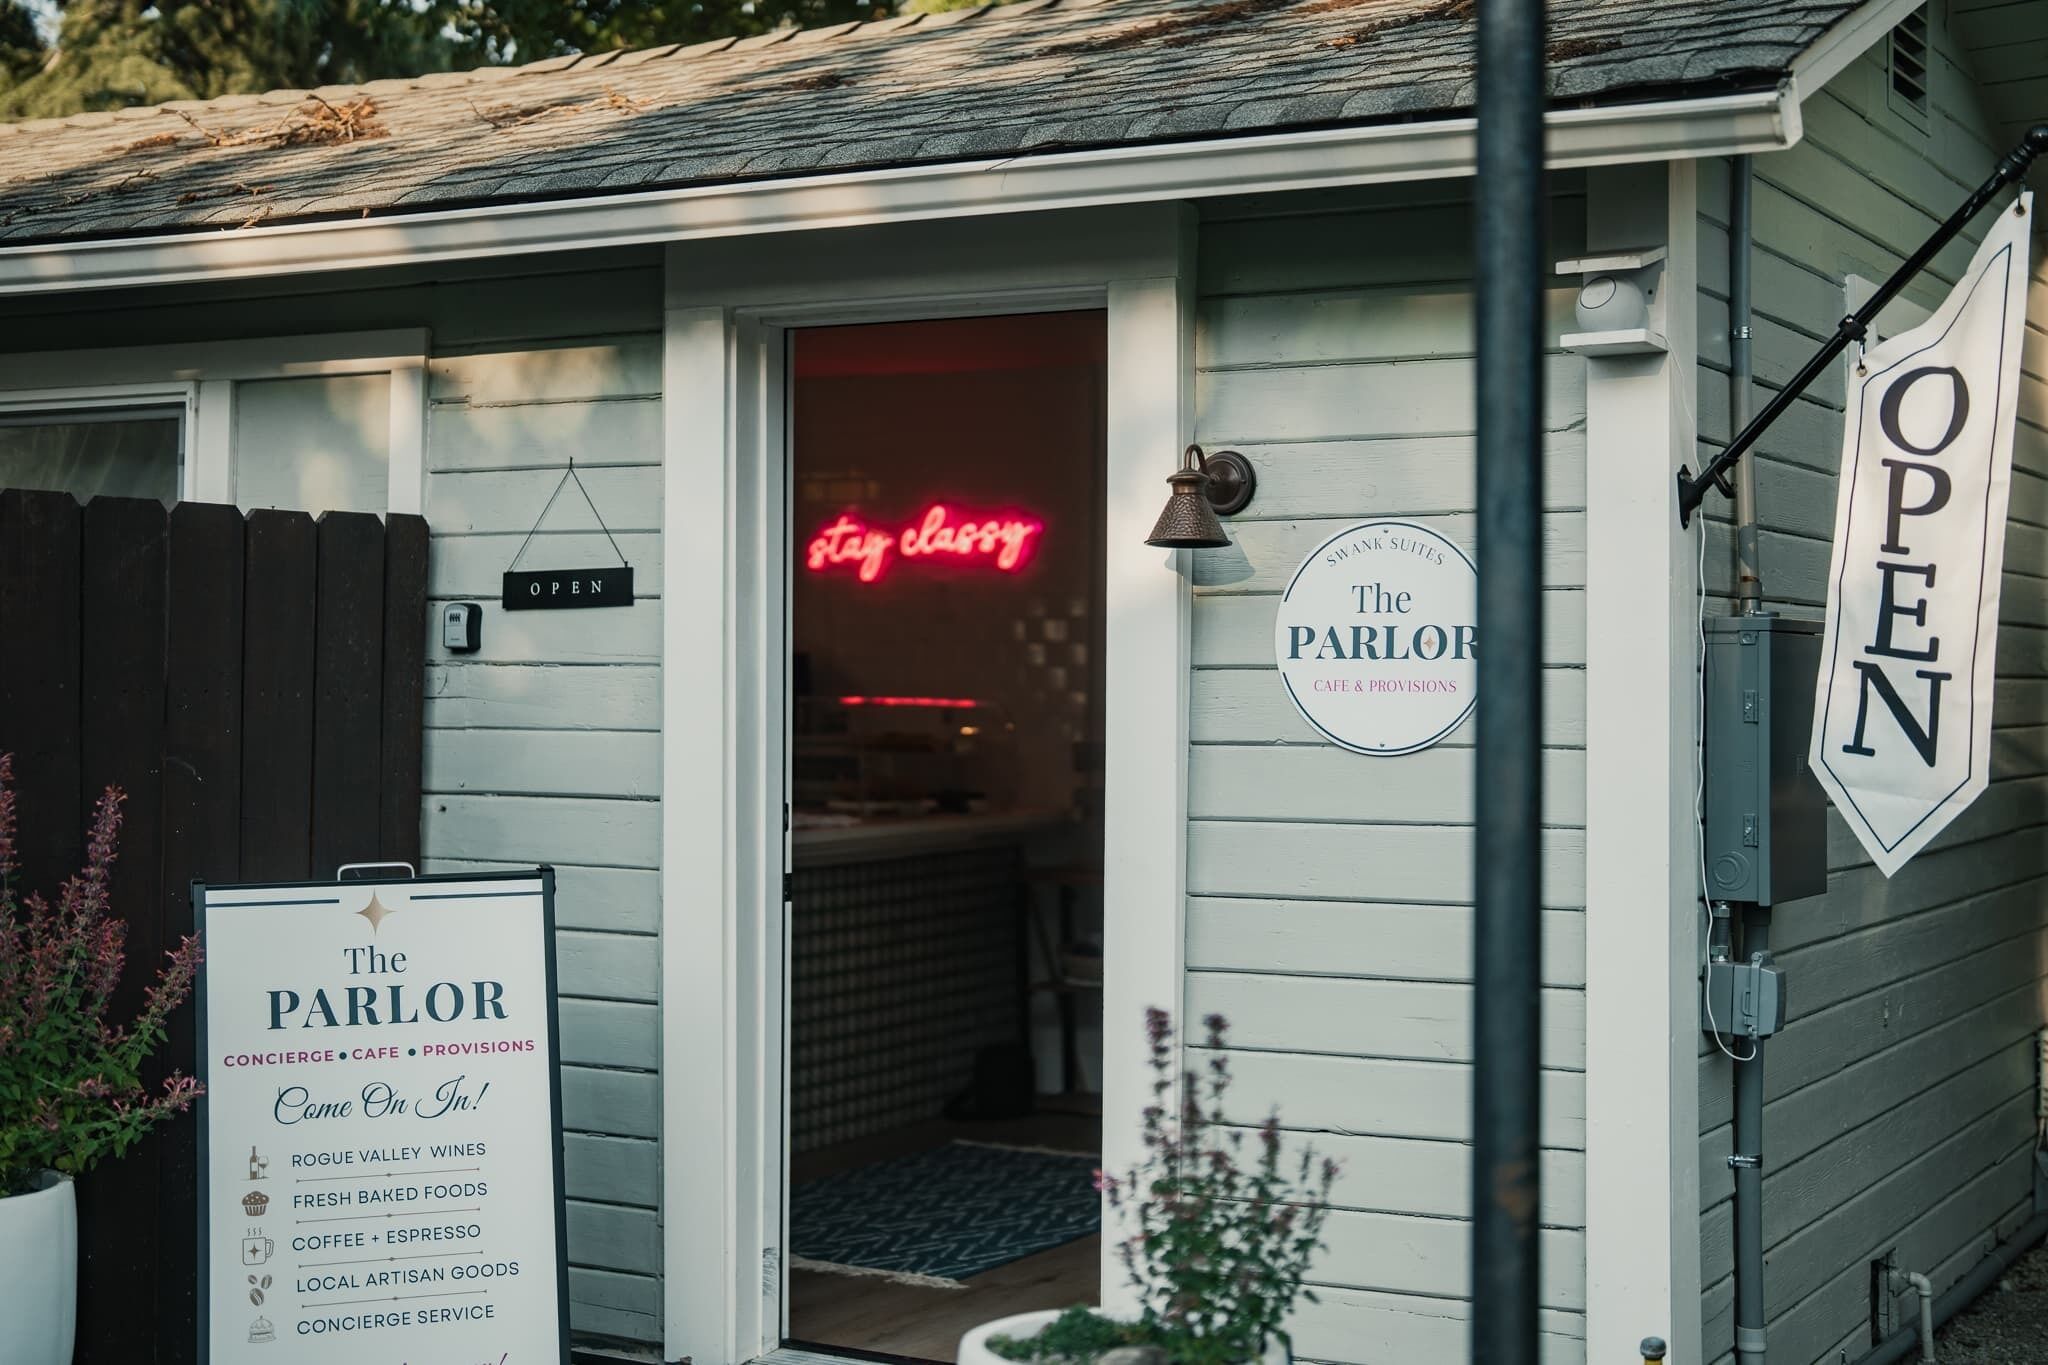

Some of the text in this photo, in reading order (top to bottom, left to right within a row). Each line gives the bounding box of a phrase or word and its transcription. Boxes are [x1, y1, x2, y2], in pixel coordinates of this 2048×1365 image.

[808, 505, 1043, 582] stay classy
[1326, 537, 1446, 567] SWANK SUITES
[1842, 366, 1970, 768] OPEN
[529, 579, 603, 596] OPEN
[1351, 582, 1412, 614] The
[1314, 679, 1457, 694] CAFE & PROVISIONS
[343, 945, 407, 975] The
[265, 980, 510, 1030] PARLOR
[223, 1039, 536, 1068] CONCIERGE CAFE PROVISIONS
[273, 1074, 490, 1126] Come On In!
[291, 1142, 487, 1168] ROGUE VALLEY WINES
[293, 1182, 488, 1209] FRESH BAKED FOODS
[291, 1224, 481, 1252] COFFEE + ESPRESSO
[296, 1261, 520, 1293] LOCAL ARTISAN GOODS
[296, 1304, 495, 1336] CONCIERGE SERVICE
